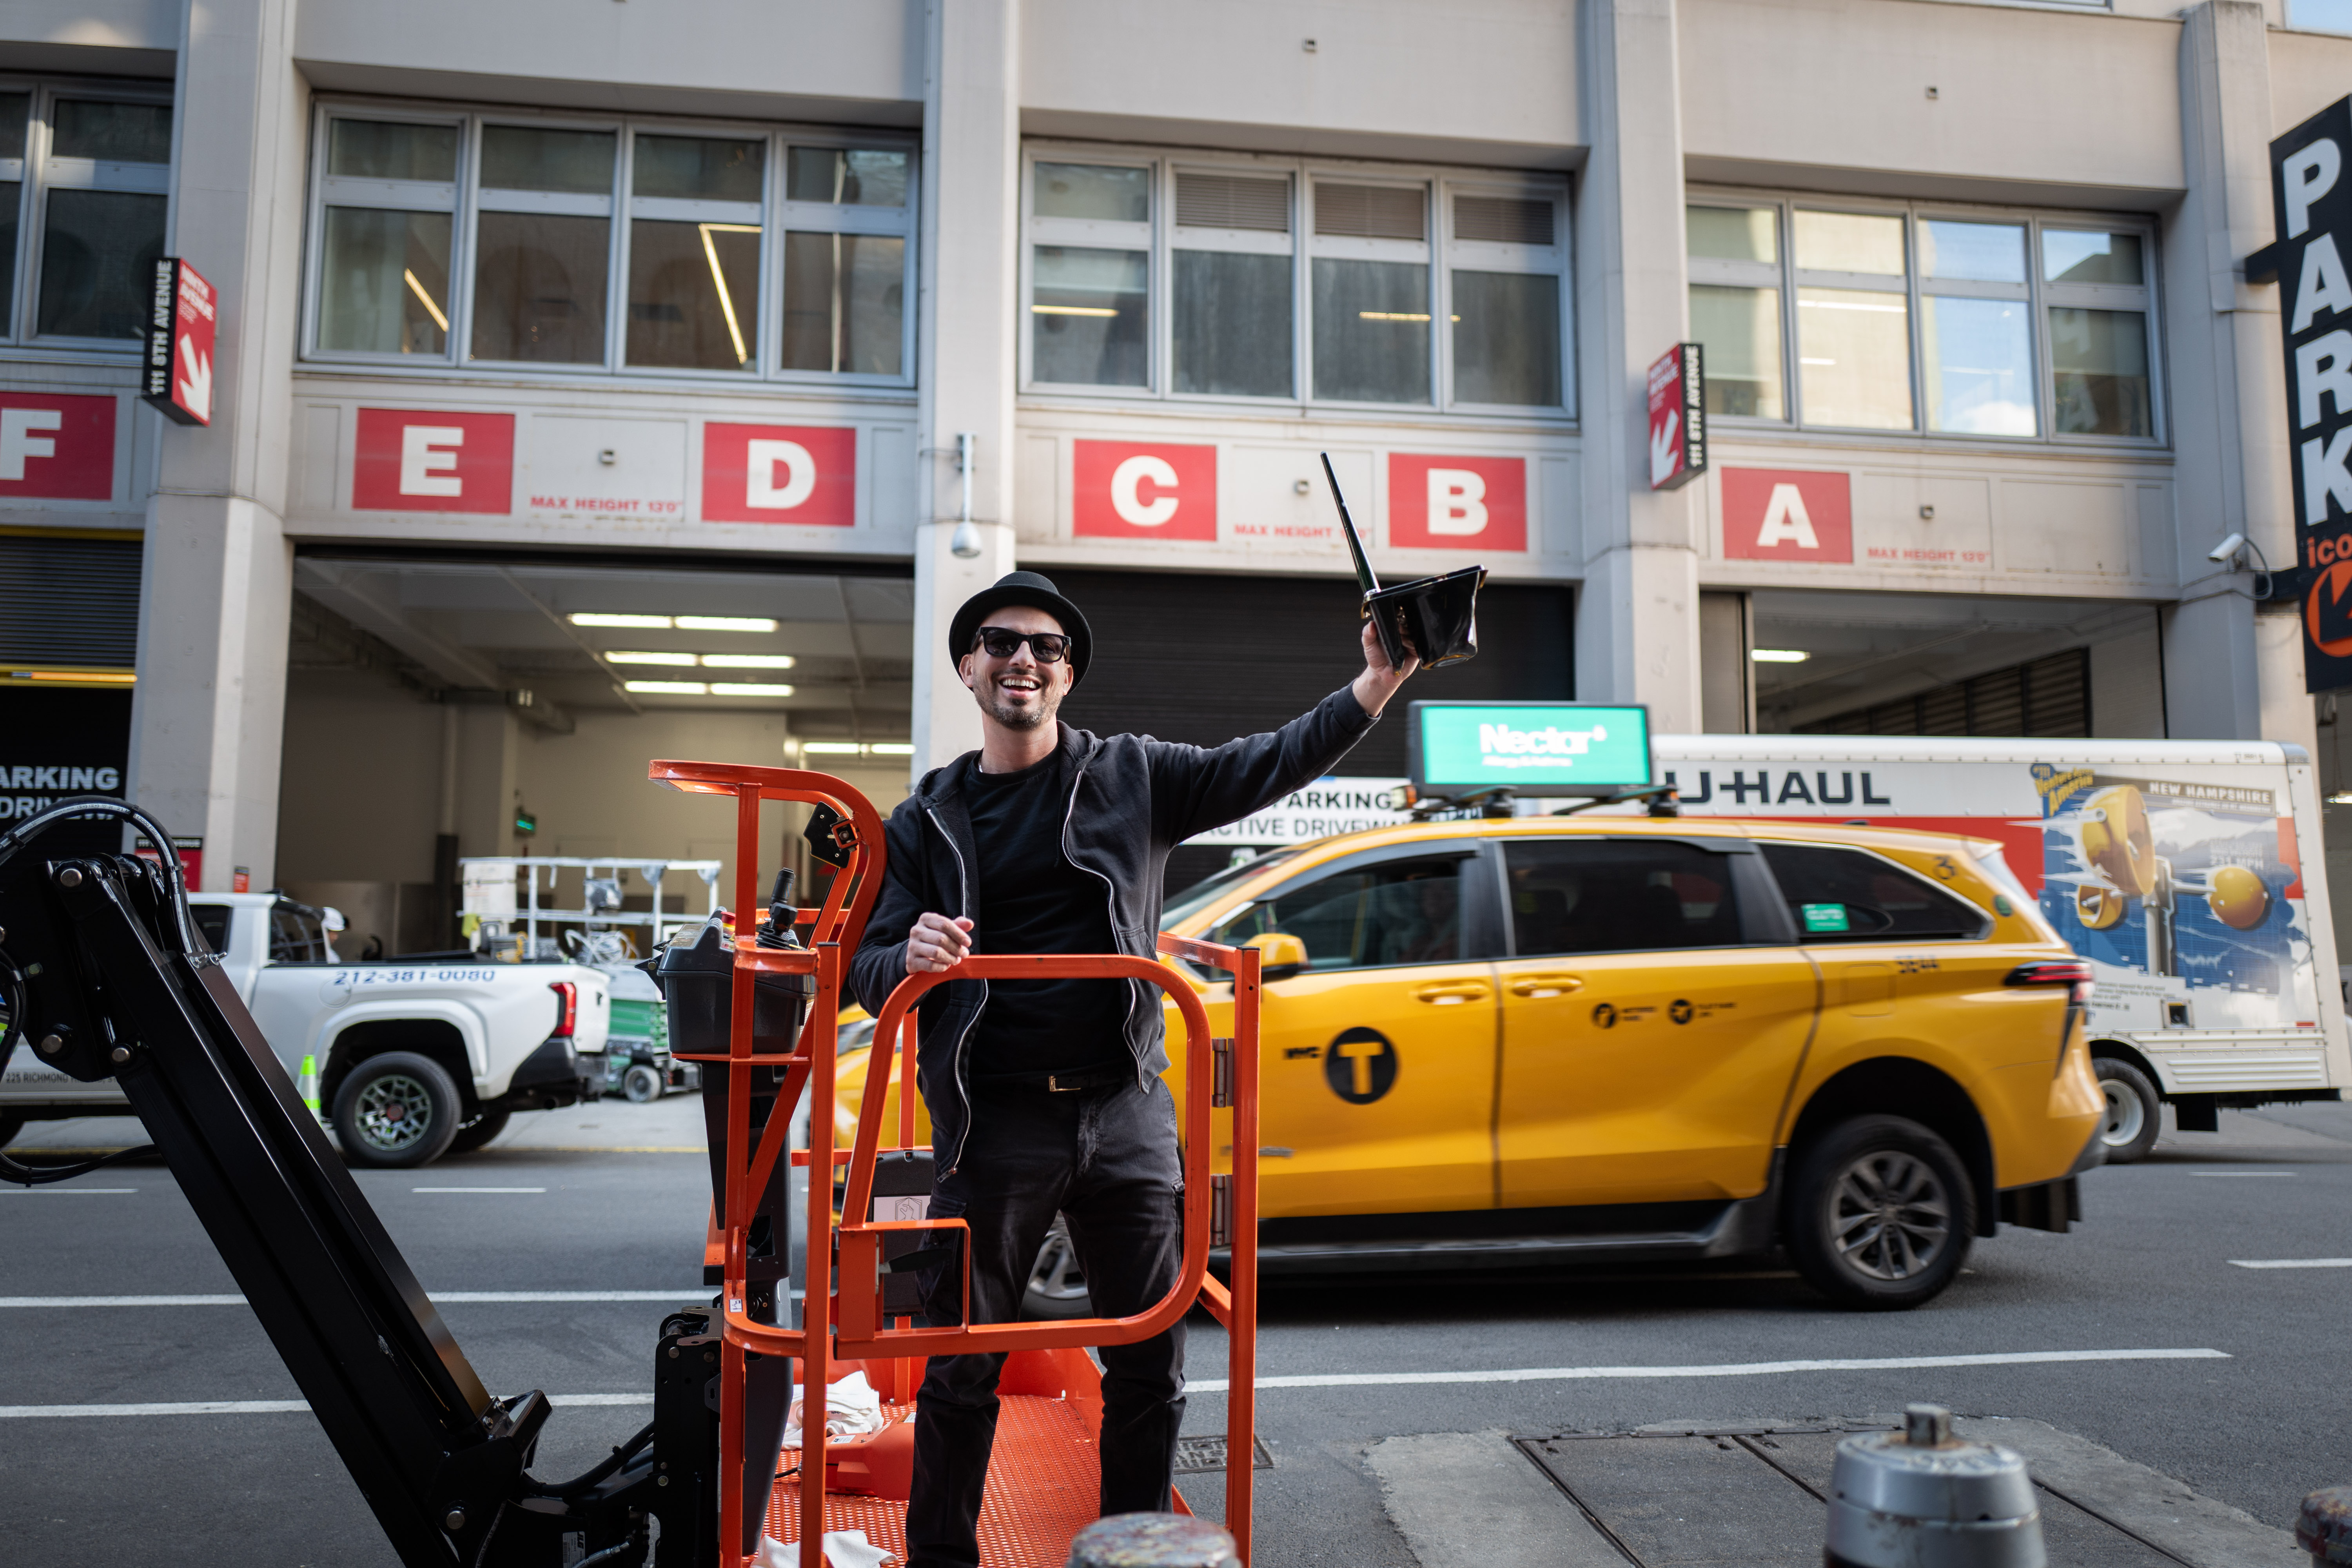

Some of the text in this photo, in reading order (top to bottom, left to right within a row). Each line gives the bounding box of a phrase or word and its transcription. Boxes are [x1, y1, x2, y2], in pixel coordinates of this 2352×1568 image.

[150, 260, 172, 395] 111 8TH AVENUE
[2283, 138, 2352, 526] PARK
[1685, 345, 1703, 467] 111 8TH AVENUE
[0, 408, 62, 480] F
[399, 425, 464, 497] E
[746, 439, 816, 509] D
[1111, 456, 1179, 526] C
[530, 496, 568, 509] MAX
[575, 498, 640, 512] HEIGHT
[1427, 468, 1488, 536] B
[1757, 483, 1819, 549] A
[1234, 524, 1267, 535] MAX
[1274, 526, 1332, 538] HEIGHT
[1867, 547, 1898, 560] MAX
[1903, 549, 1956, 561] HEIGHT
[1479, 724, 1592, 754] Nectar
[1273, 792, 1392, 810] ARKING
[1665, 771, 1891, 804] U-HAUL
[2049, 776, 2093, 817] America
[2150, 782, 2270, 804] NEW HAMPSHIRE
[137, 815, 158, 835] (3000 PSI)
[334, 970, 495, 986] 212-381-0080
[23, 1072, 69, 1083] RICHMOND
[1337, 1042, 1385, 1095] T
